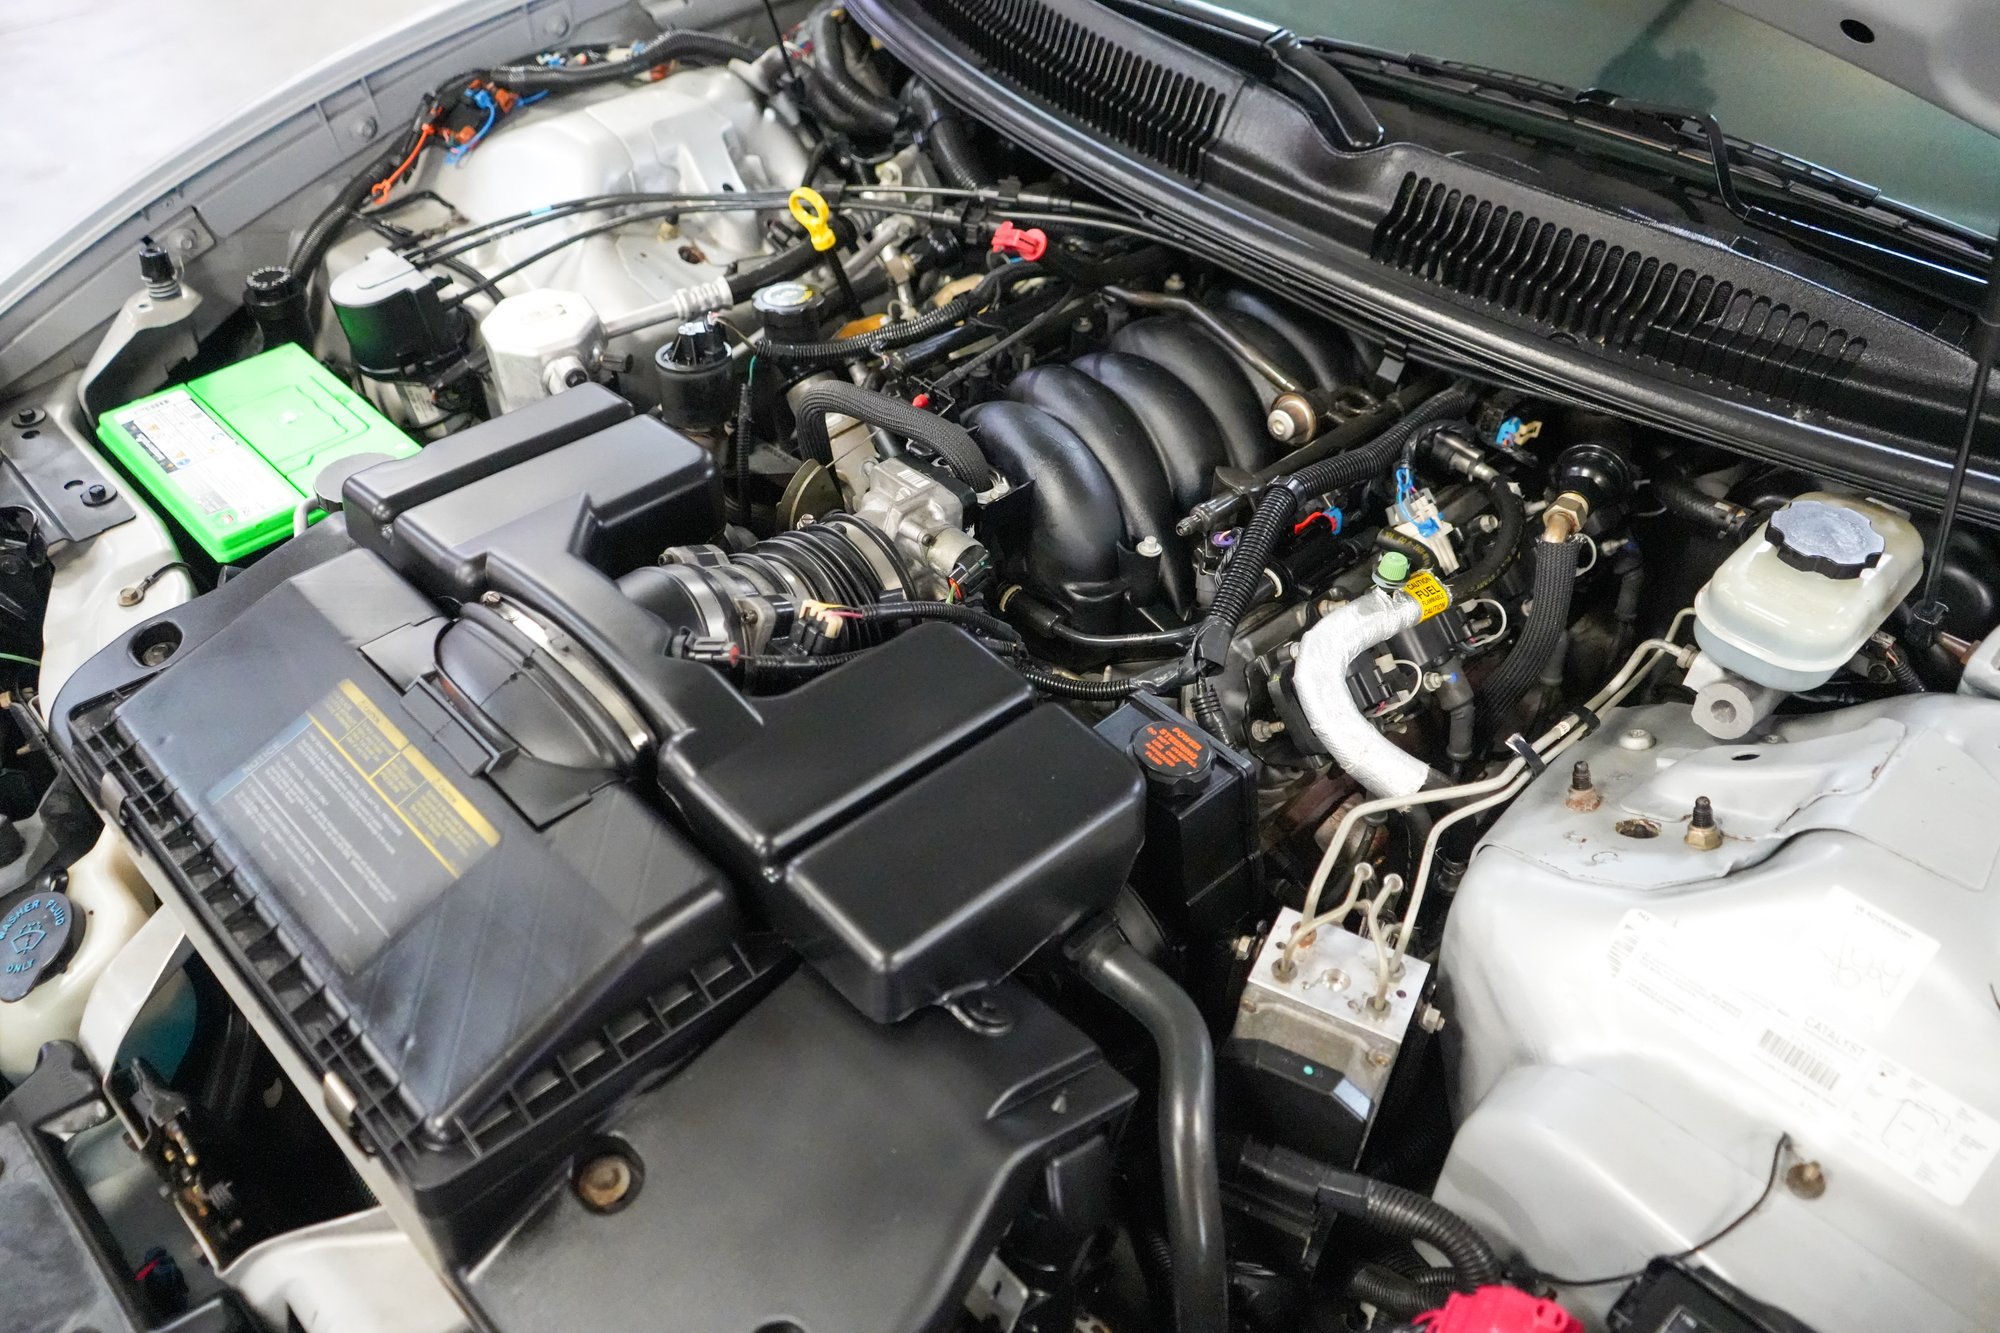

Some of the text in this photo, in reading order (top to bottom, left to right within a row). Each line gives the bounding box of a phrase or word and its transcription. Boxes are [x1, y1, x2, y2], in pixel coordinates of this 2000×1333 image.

[1406, 576, 1432, 590] CAUTION
[1415, 585, 1441, 599] FUEL
[1422, 593, 1445, 605] FLAMMABLE
[1423, 602, 1447, 617] CAUTION
[1159, 728, 1198, 760] STEERING
[1172, 727, 1202, 751] POWER
[1145, 743, 1176, 767] APPROVED
[1145, 751, 1163, 766] FLUID
[1165, 750, 1181, 762] ONLY
[45, 899, 66, 928] FLUID
[6, 958, 35, 974] ONLY
[1804, 1015, 1866, 1057] CATALYST
